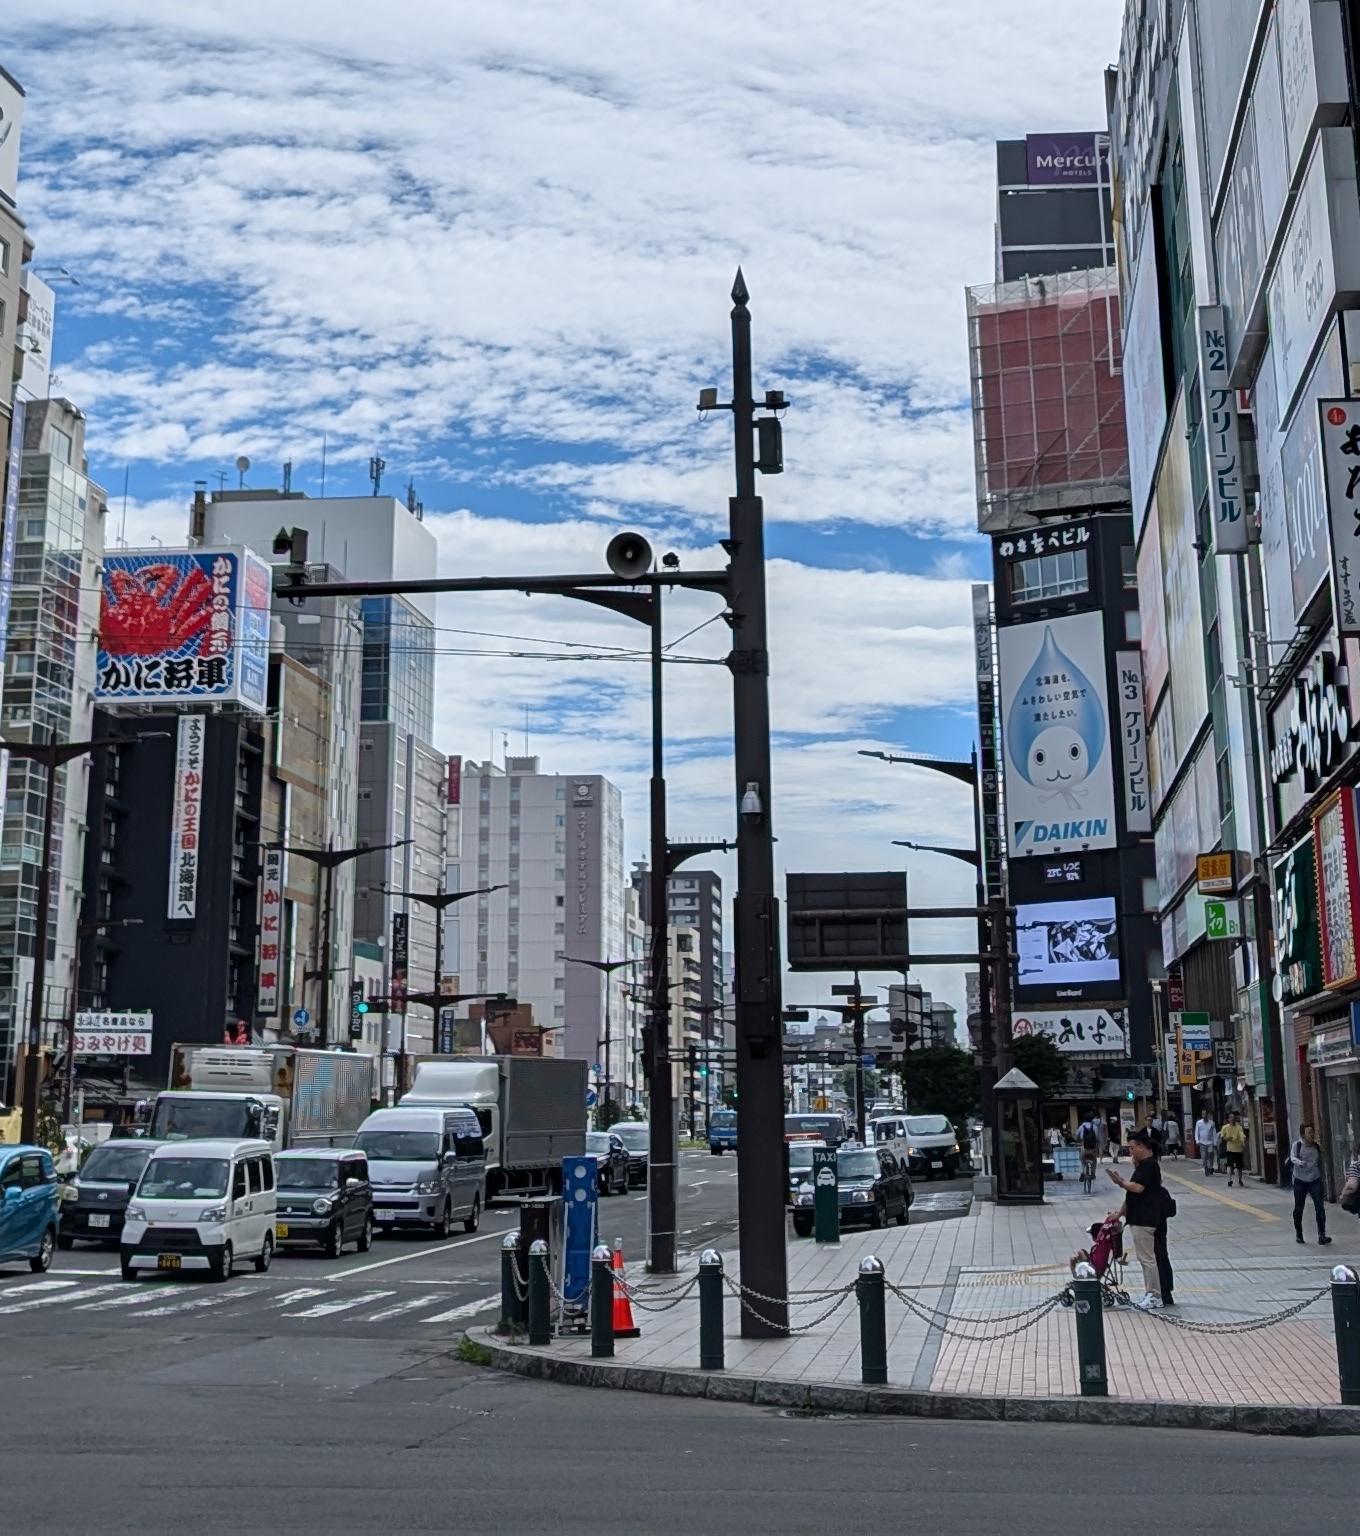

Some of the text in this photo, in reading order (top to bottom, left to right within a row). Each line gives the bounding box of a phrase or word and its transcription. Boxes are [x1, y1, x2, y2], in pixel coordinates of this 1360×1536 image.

[1209, 389, 1240, 523] グリーンビル
[100, 656, 228, 691] かに将軍
[1124, 711, 1150, 812] グリーンビル
[1032, 818, 1108, 844] DAIKIN
[814, 1152, 837, 1163] TAXI
